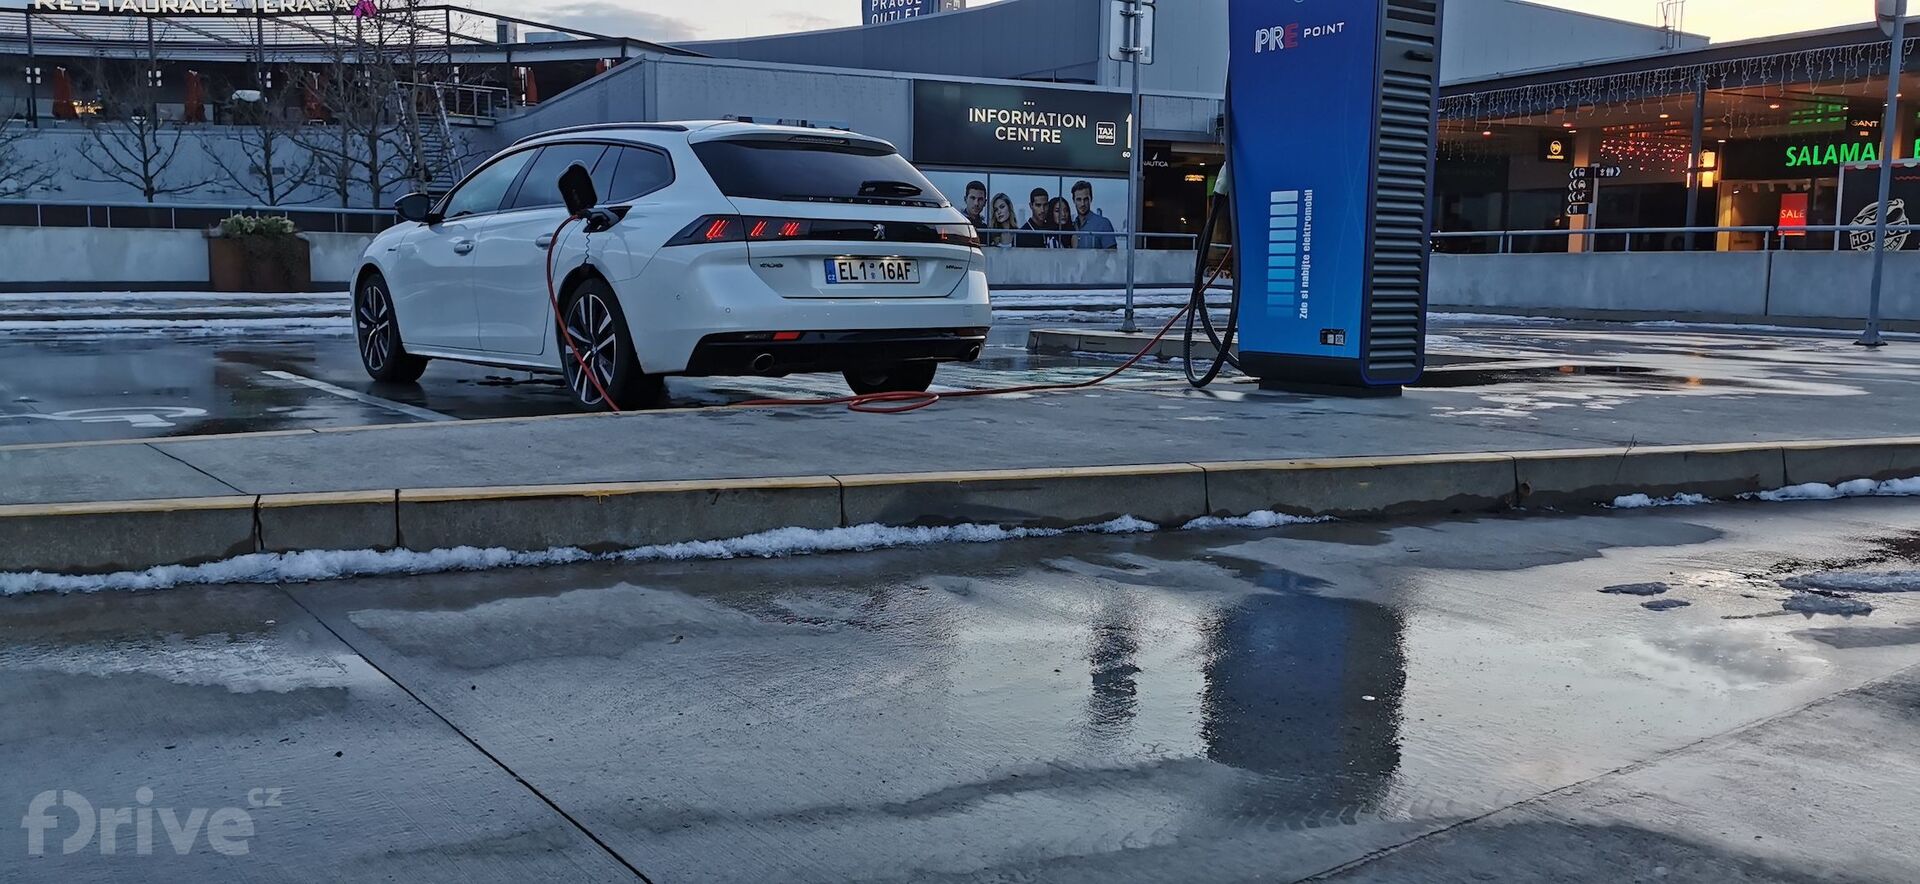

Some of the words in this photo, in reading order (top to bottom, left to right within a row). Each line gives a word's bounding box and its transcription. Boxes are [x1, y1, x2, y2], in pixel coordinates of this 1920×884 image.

[34, 0, 238, 14] RESTAURACE
[1255, 22, 1299, 53] PRE
[1303, 22, 1345, 38] POINT
[968, 107, 1087, 129] INFORMATION
[1850, 120, 1879, 128] GANT
[995, 126, 1062, 144] CENTRE
[1098, 127, 1114, 136] TAX
[1143, 160, 1169, 168] NAUTICA
[1303, 189, 1313, 252] elektromobil
[1781, 209, 1805, 219] SALE
[1852, 230, 1875, 246] HOT
[838, 261, 867, 281] EL1
[878, 261, 912, 281] 16AF
[1302, 254, 1311, 288] nabijte
[1301, 290, 1309, 300] si
[1300, 301, 1308, 319] Zde
